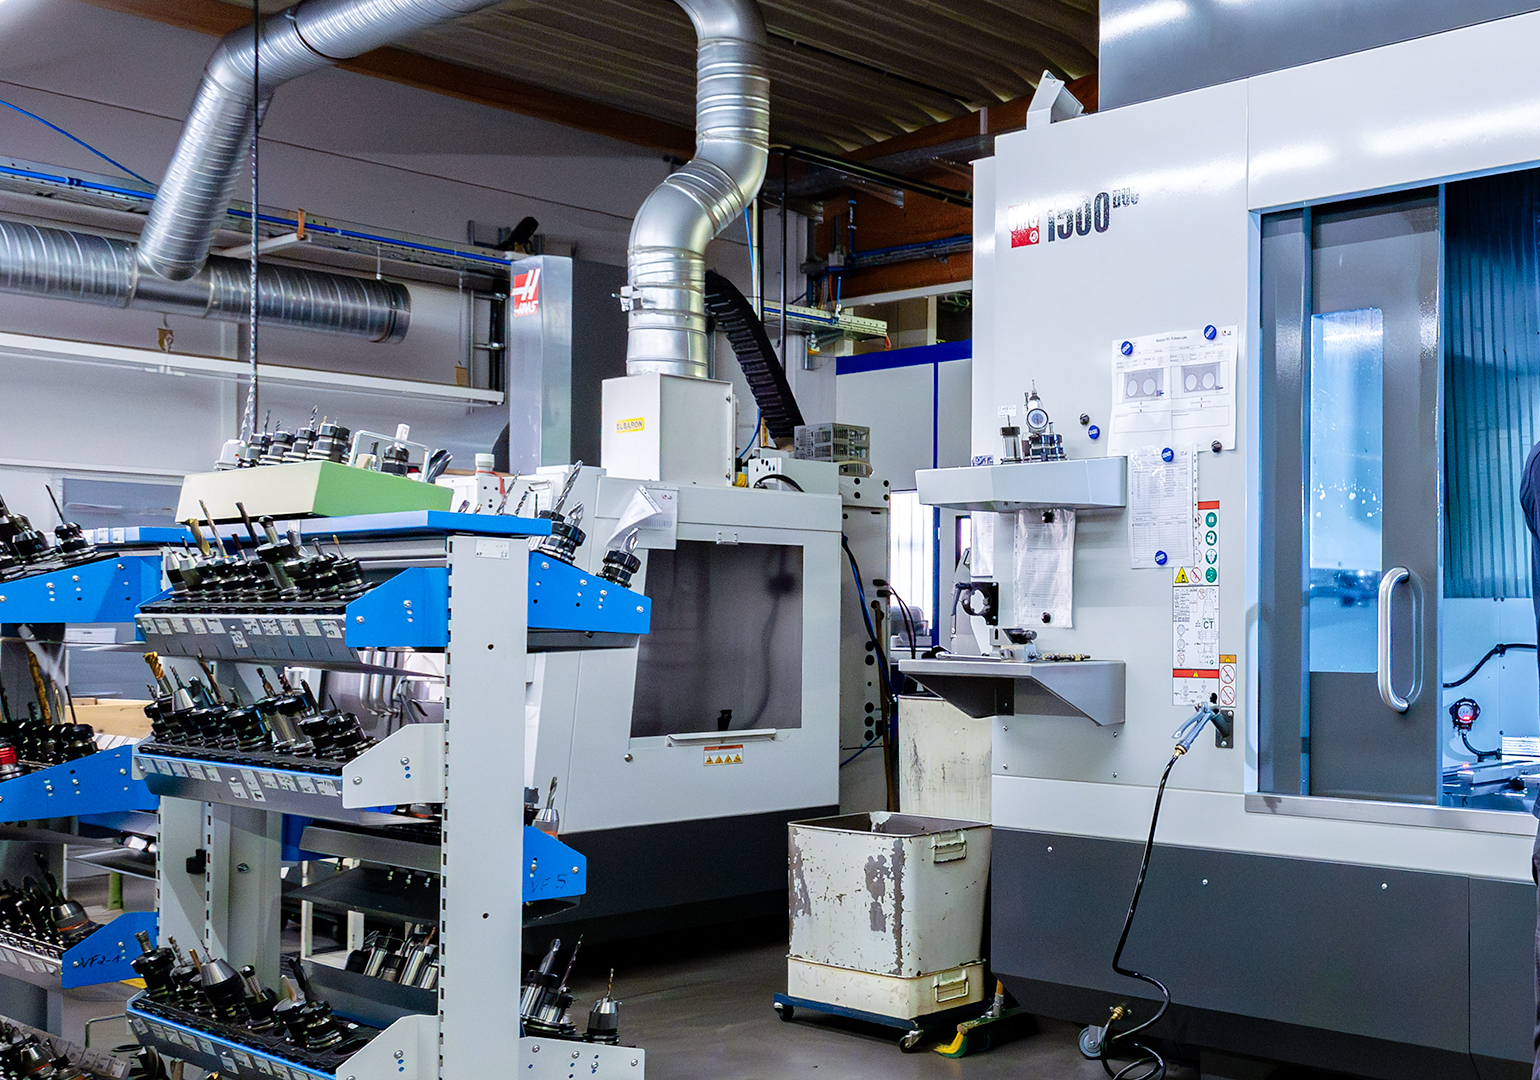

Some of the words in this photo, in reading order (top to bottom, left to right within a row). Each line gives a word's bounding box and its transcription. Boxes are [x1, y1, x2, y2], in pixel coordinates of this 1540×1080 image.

[1047, 191, 1110, 243] 1500
[616, 420, 643, 431] ELBARON
[1203, 620, 1215, 630] CT
